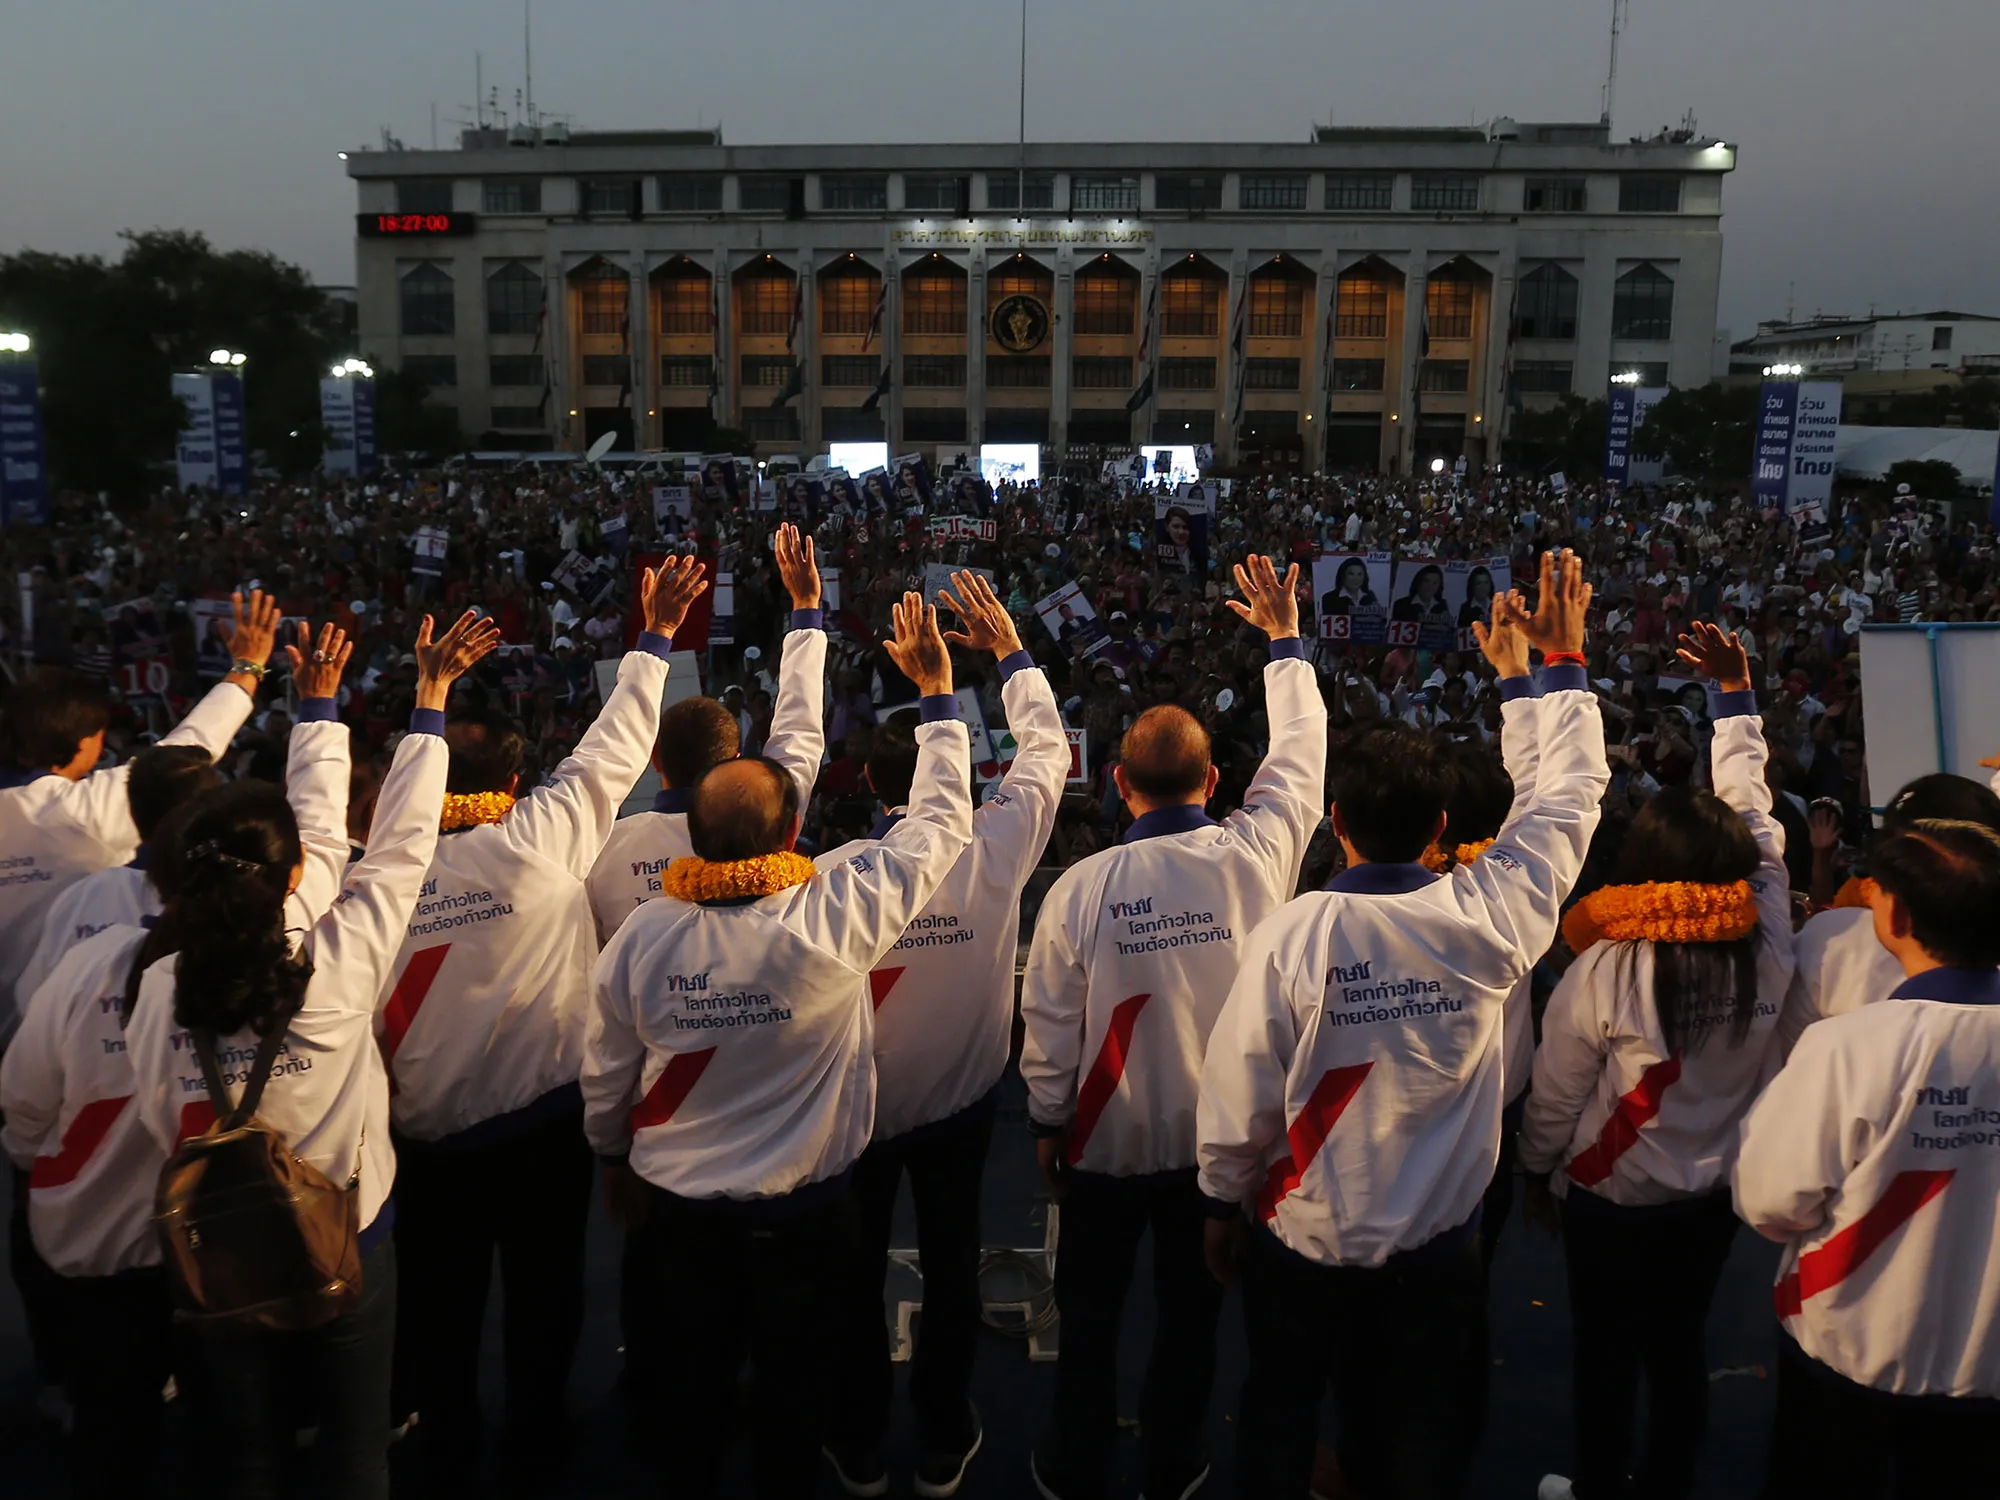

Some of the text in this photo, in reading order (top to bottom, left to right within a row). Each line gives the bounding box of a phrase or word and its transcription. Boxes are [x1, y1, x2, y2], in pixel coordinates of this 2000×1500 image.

[378, 215, 449, 232] 18:27:00
[1800, 397, 1825, 410] ร่วม
[1798, 413, 1837, 424] กำหนด
[1797, 430, 1835, 438] อนาคต
[1796, 444, 1833, 452] ประเทศ
[1760, 458, 1783, 479] ไทย
[1795, 457, 1832, 475] ไทย
[980, 521, 994, 540] 10
[1160, 546, 1172, 555] 10
[1322, 616, 1350, 637] 13
[1392, 622, 1418, 643] 13
[122, 661, 170, 694] 10
[416, 891, 493, 916] โลกก้าวไกล
[1128, 912, 1213, 935] โลกก้าวไกล
[1116, 927, 1232, 955] ไทยต้องก้าวทัน
[684, 992, 771, 1010] โลกก้าวไกล
[1342, 978, 1441, 1004] โลกก้าวไกล
[672, 1008, 792, 1030] ไทยต้องก้าวทัน
[1328, 998, 1462, 1026] ไทยต้องก้าวทัน
